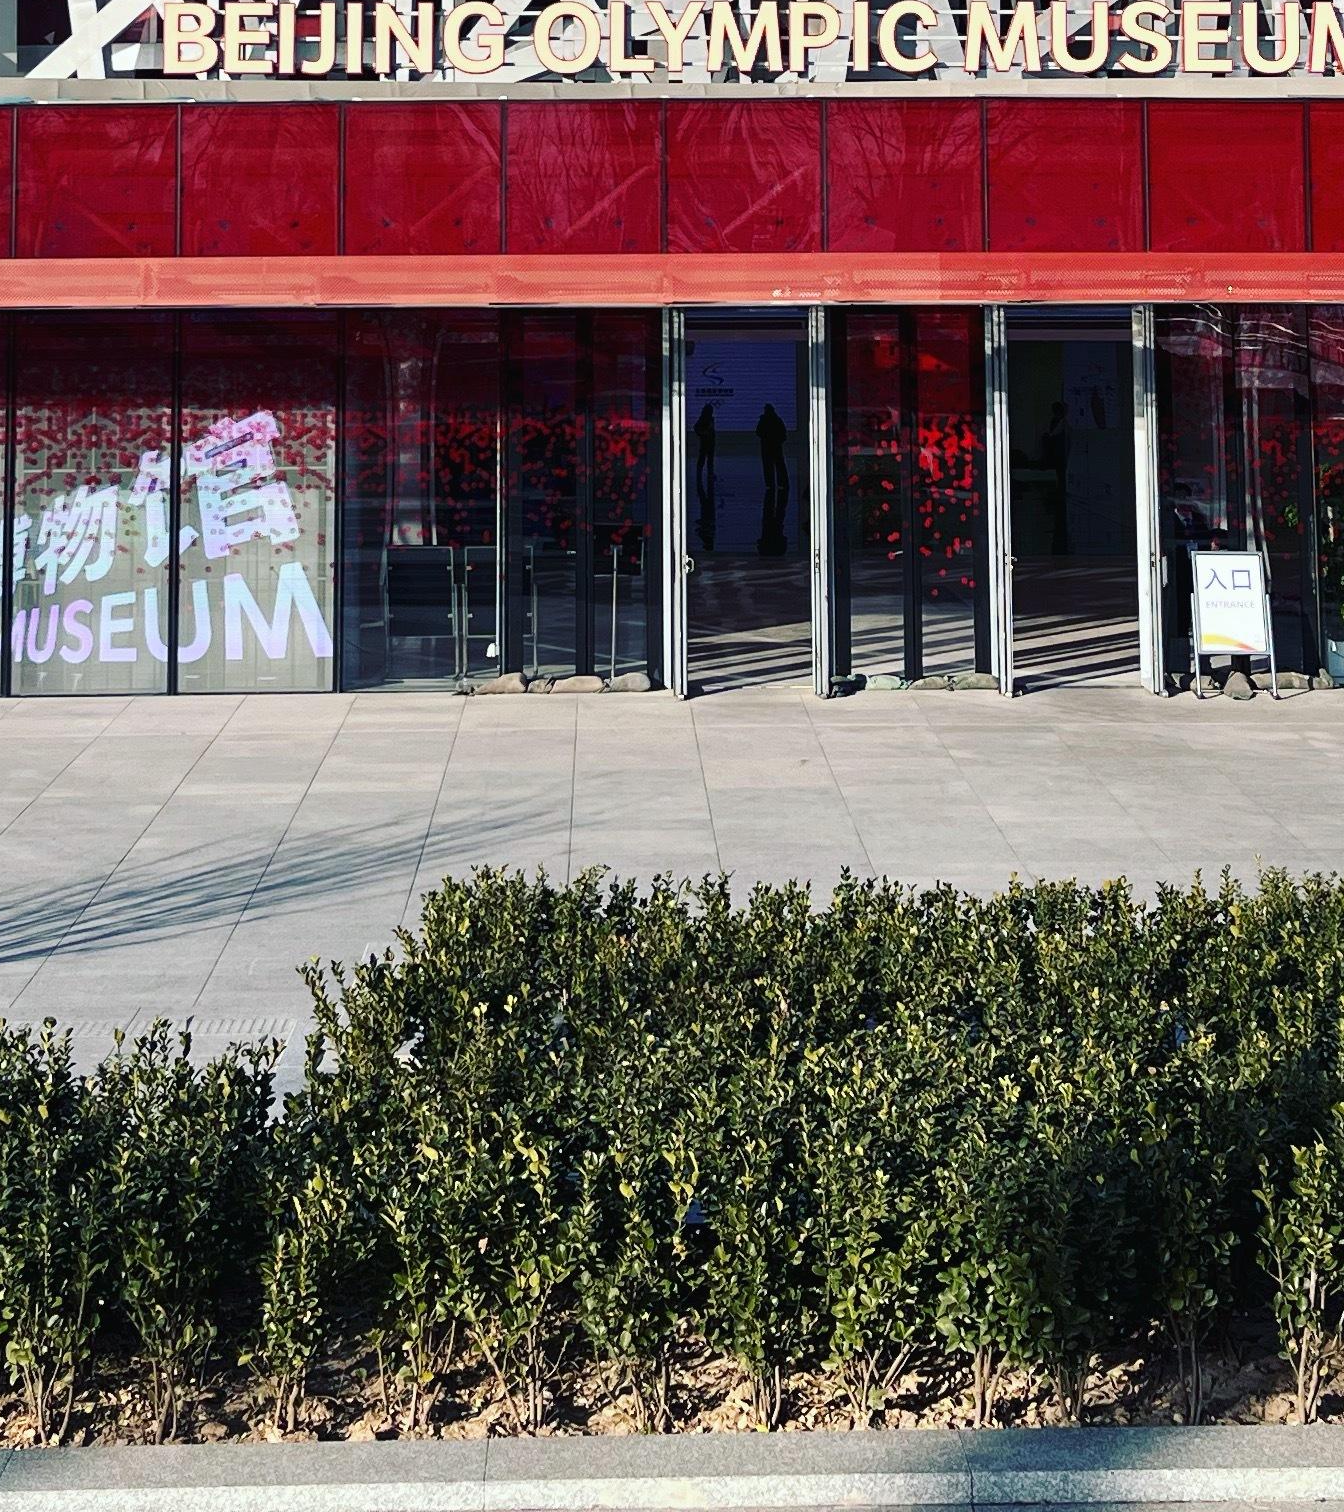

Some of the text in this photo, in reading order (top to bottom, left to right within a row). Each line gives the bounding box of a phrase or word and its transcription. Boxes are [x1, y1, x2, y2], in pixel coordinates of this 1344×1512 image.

[162, 0, 506, 75] BEIJING
[532, 0, 940, 75] OLYMPIC
[1205, 568, 1252, 590] 入口
[1206, 600, 1256, 609] ENTRANCE
